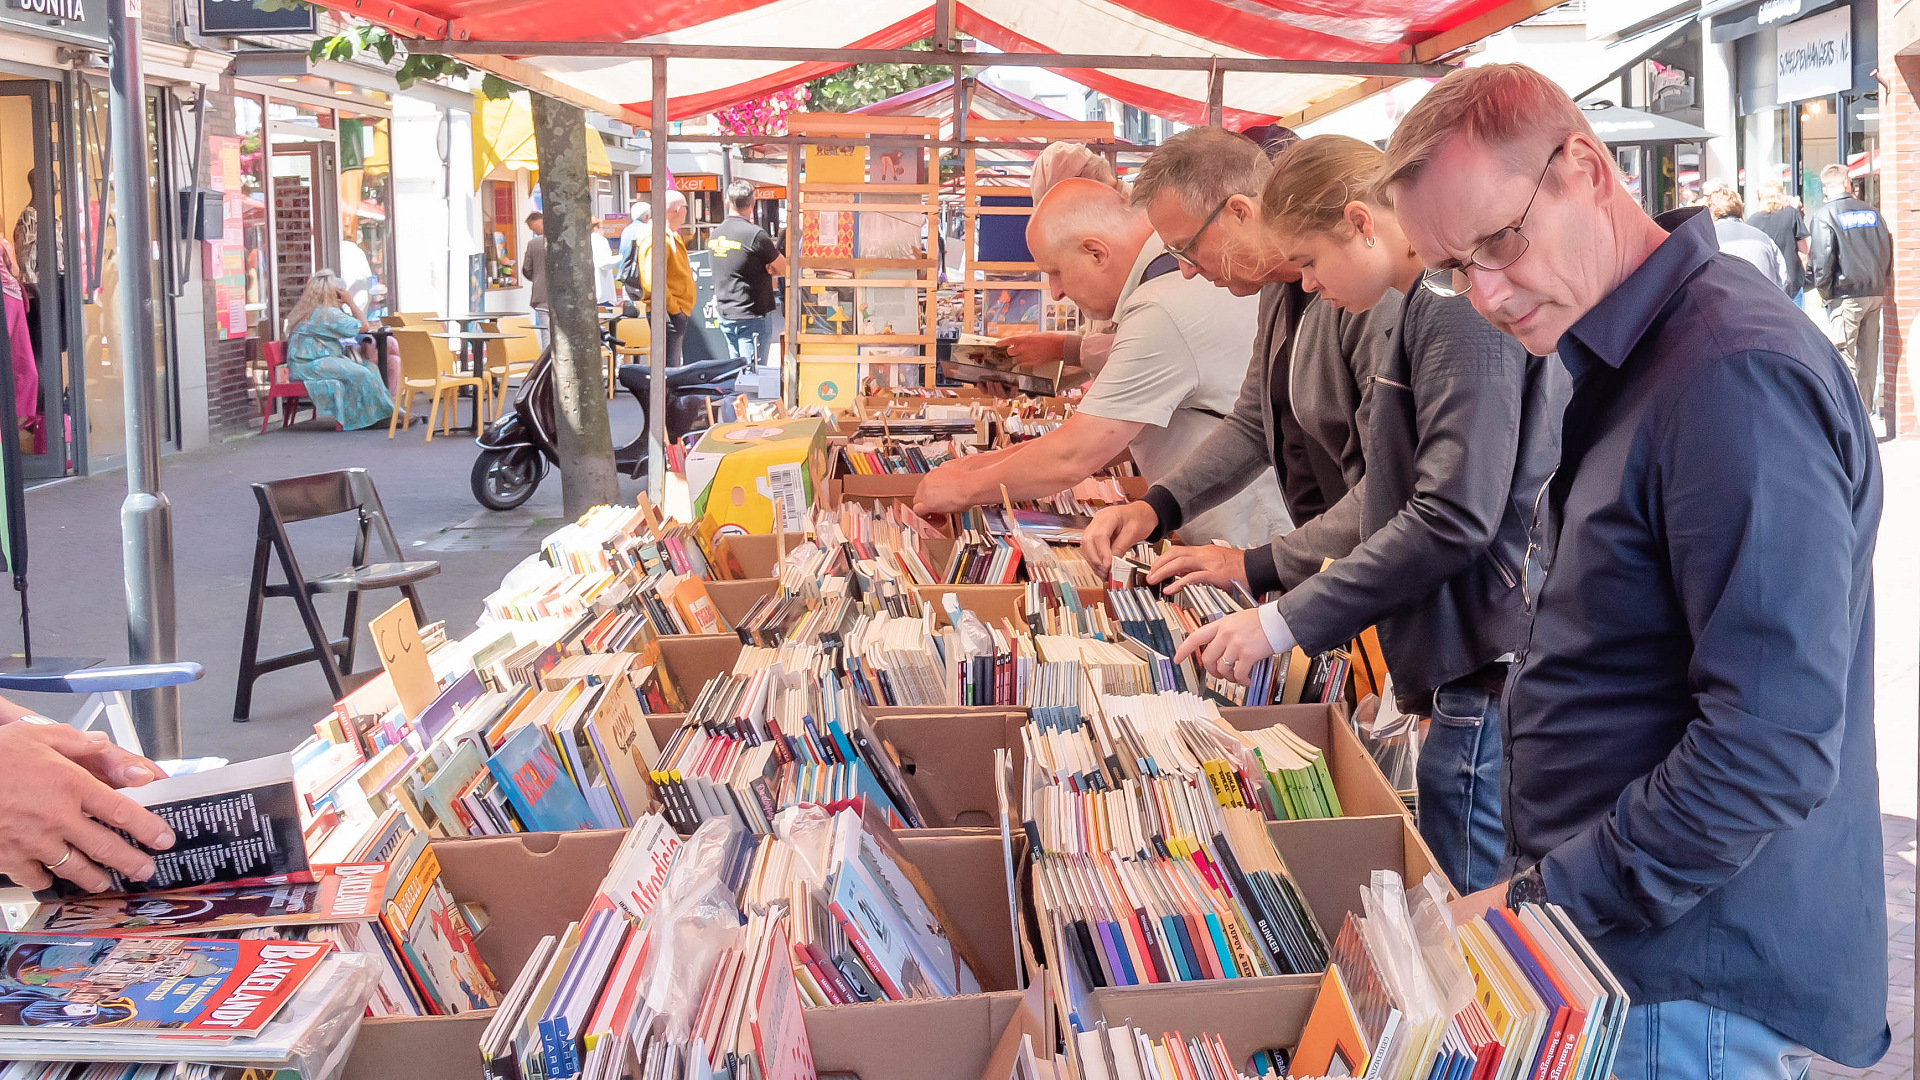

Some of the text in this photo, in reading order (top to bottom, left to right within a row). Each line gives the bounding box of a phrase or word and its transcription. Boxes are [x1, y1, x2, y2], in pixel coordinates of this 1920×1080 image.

[512, 743, 561, 807] BERLIN
[1209, 773, 1222, 796] SOKAL
[1225, 771, 1237, 794] SOKAL
[329, 864, 386, 916] BAKELANDT
[1228, 923, 1243, 951] DUPUY
[1258, 919, 1281, 955] BUNKER
[200, 944, 322, 1027] BAKELANDT
